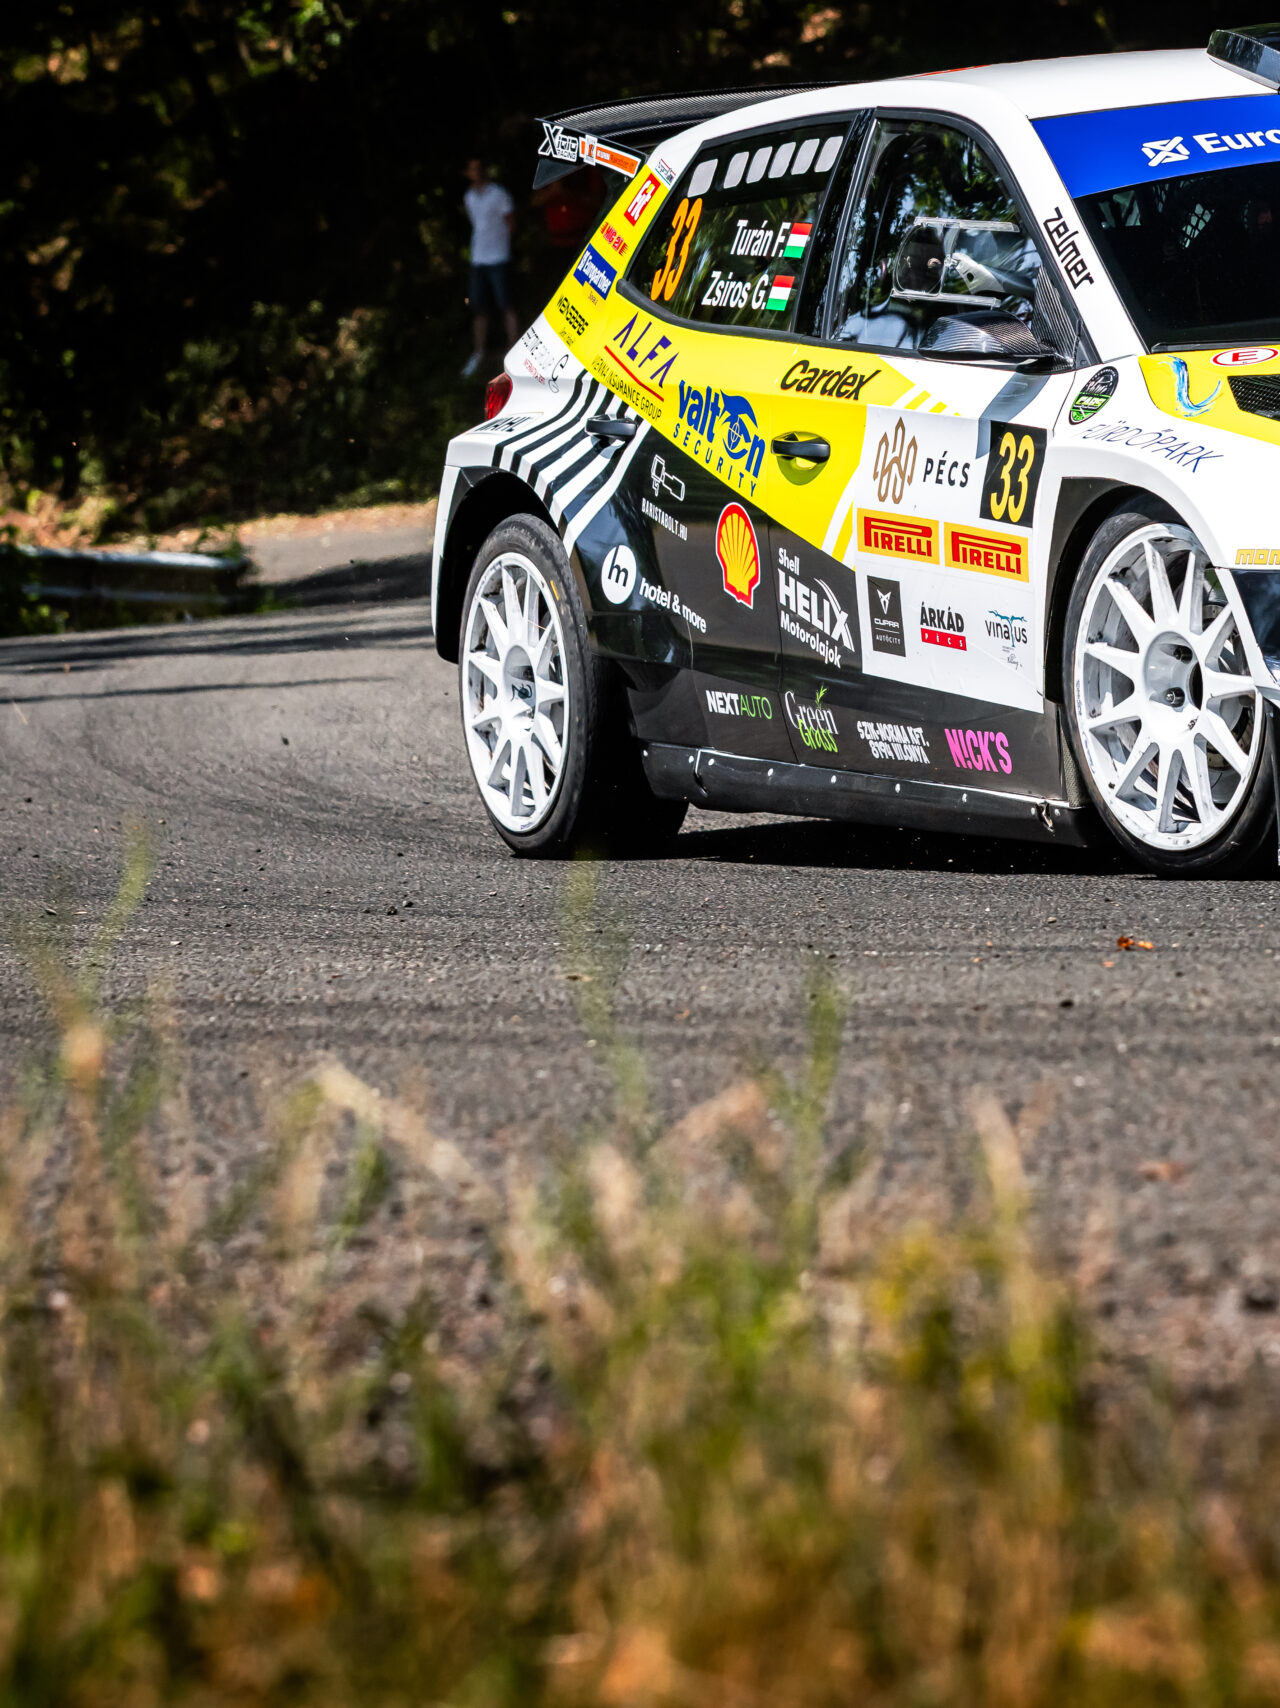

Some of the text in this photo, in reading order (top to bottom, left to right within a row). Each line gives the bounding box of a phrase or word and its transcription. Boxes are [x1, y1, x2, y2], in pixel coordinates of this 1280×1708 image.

[650, 198, 703, 301] 33
[730, 219, 792, 258] Turán F.
[1043, 207, 1094, 290] zelmer
[701, 270, 770, 310] Zsiros G.
[613, 312, 680, 388] ALFA
[1231, 350, 1259, 363] E
[606, 371, 641, 406] INSURANCE
[640, 396, 662, 421] GROUP
[779, 359, 882, 401] Cardex
[673, 422, 757, 498] SECURITY
[922, 450, 972, 489] PÉCS
[990, 431, 1036, 523] 33
[641, 497, 688, 542] BARISTABOLT.HU
[778, 547, 800, 573] Shell
[863, 515, 1022, 575] PIRELLI PIRELLI
[638, 577, 707, 634] hotel & more
[777, 567, 856, 653] HELIX
[874, 617, 900, 629] CUPRA
[920, 601, 965, 633] ÁRKÁD
[780, 610, 842, 669] Motorolajok
[784, 689, 840, 735] Green
[798, 718, 839, 753] Grass
[906, 726, 930, 747] KFT.
